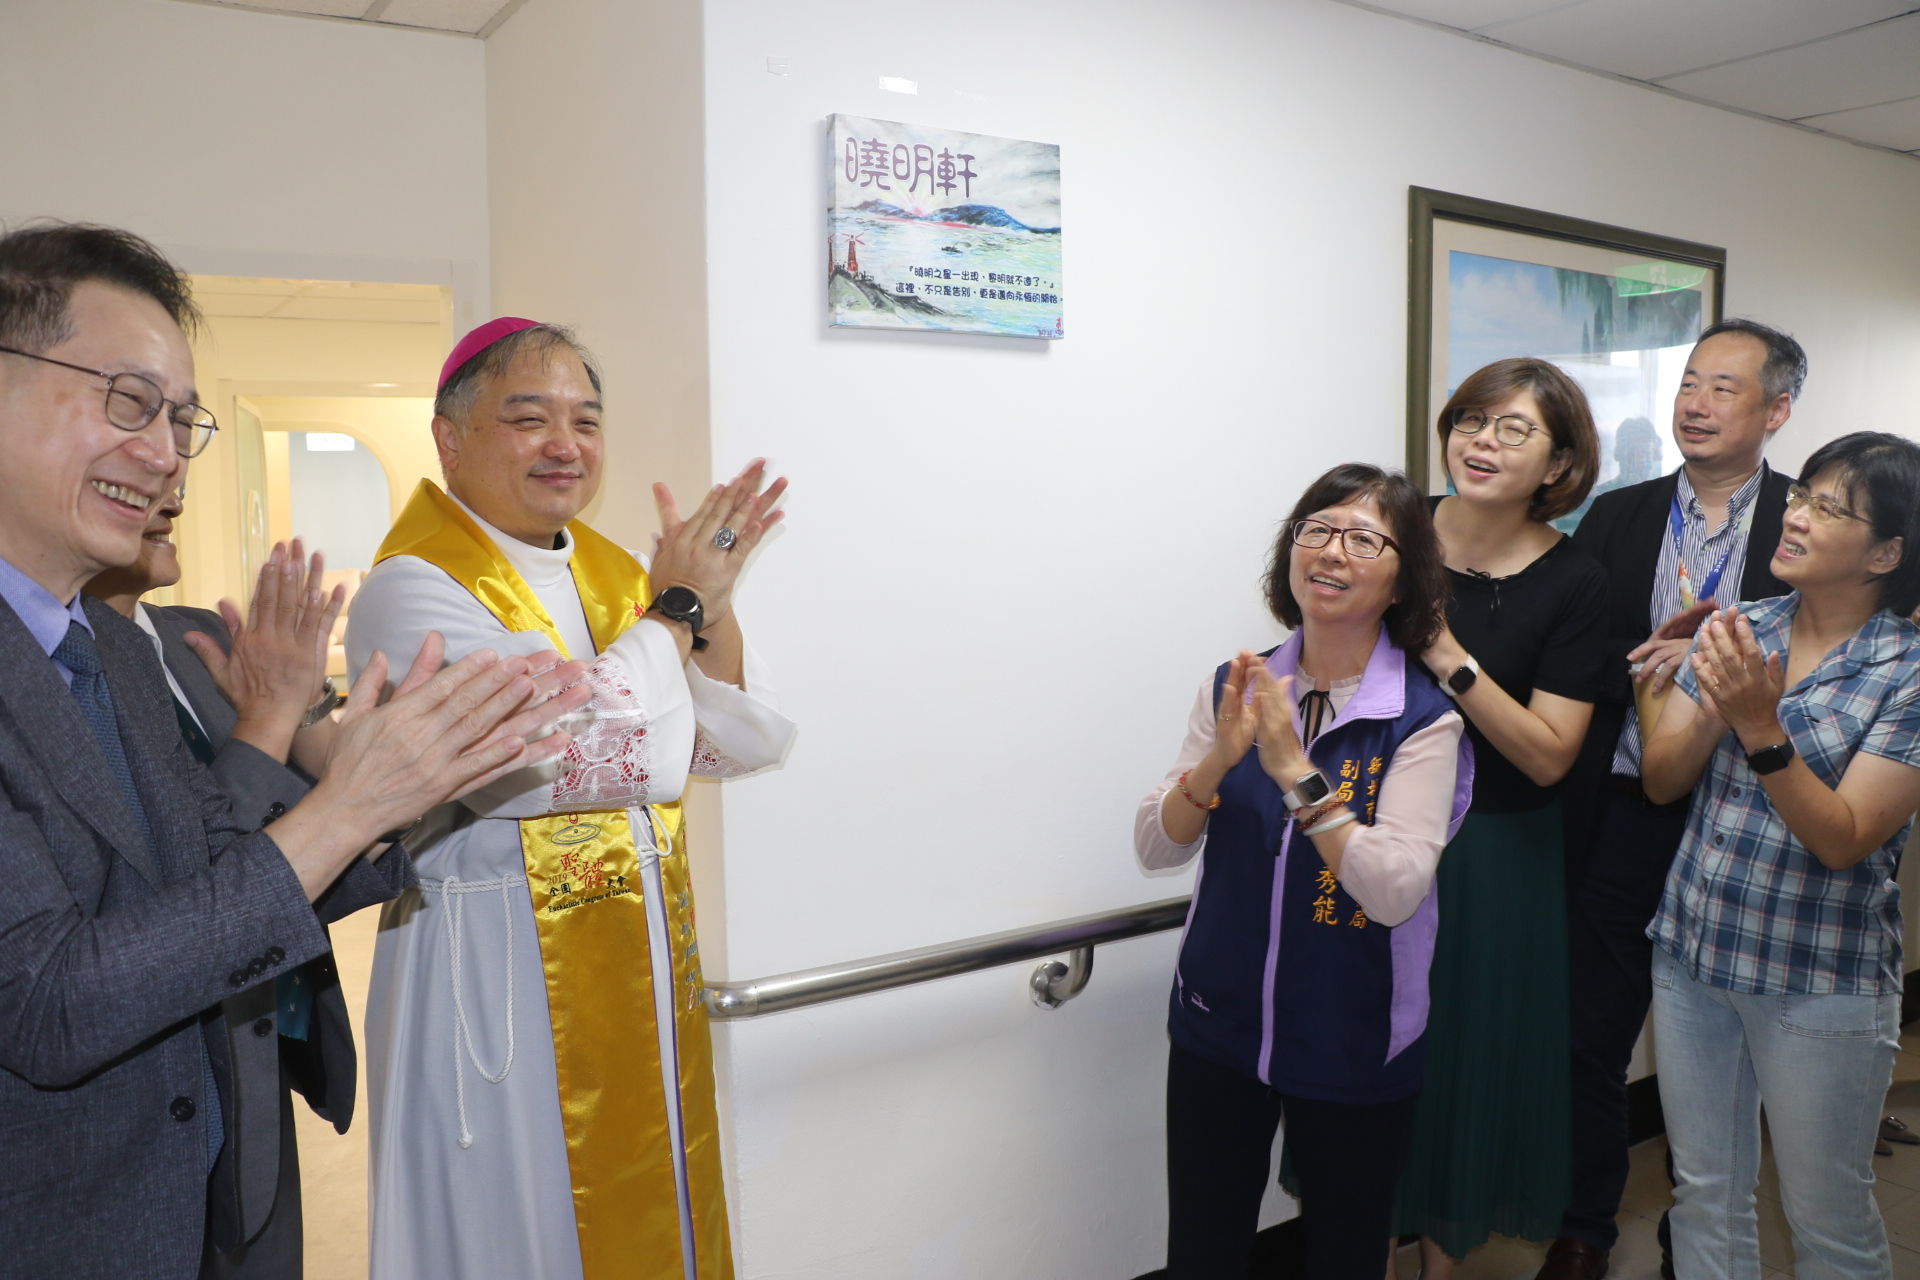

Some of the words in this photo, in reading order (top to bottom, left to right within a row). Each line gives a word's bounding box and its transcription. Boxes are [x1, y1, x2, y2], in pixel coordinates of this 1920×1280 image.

[845, 136, 978, 198] 曉明軒
[548, 873, 568, 886] 2019
